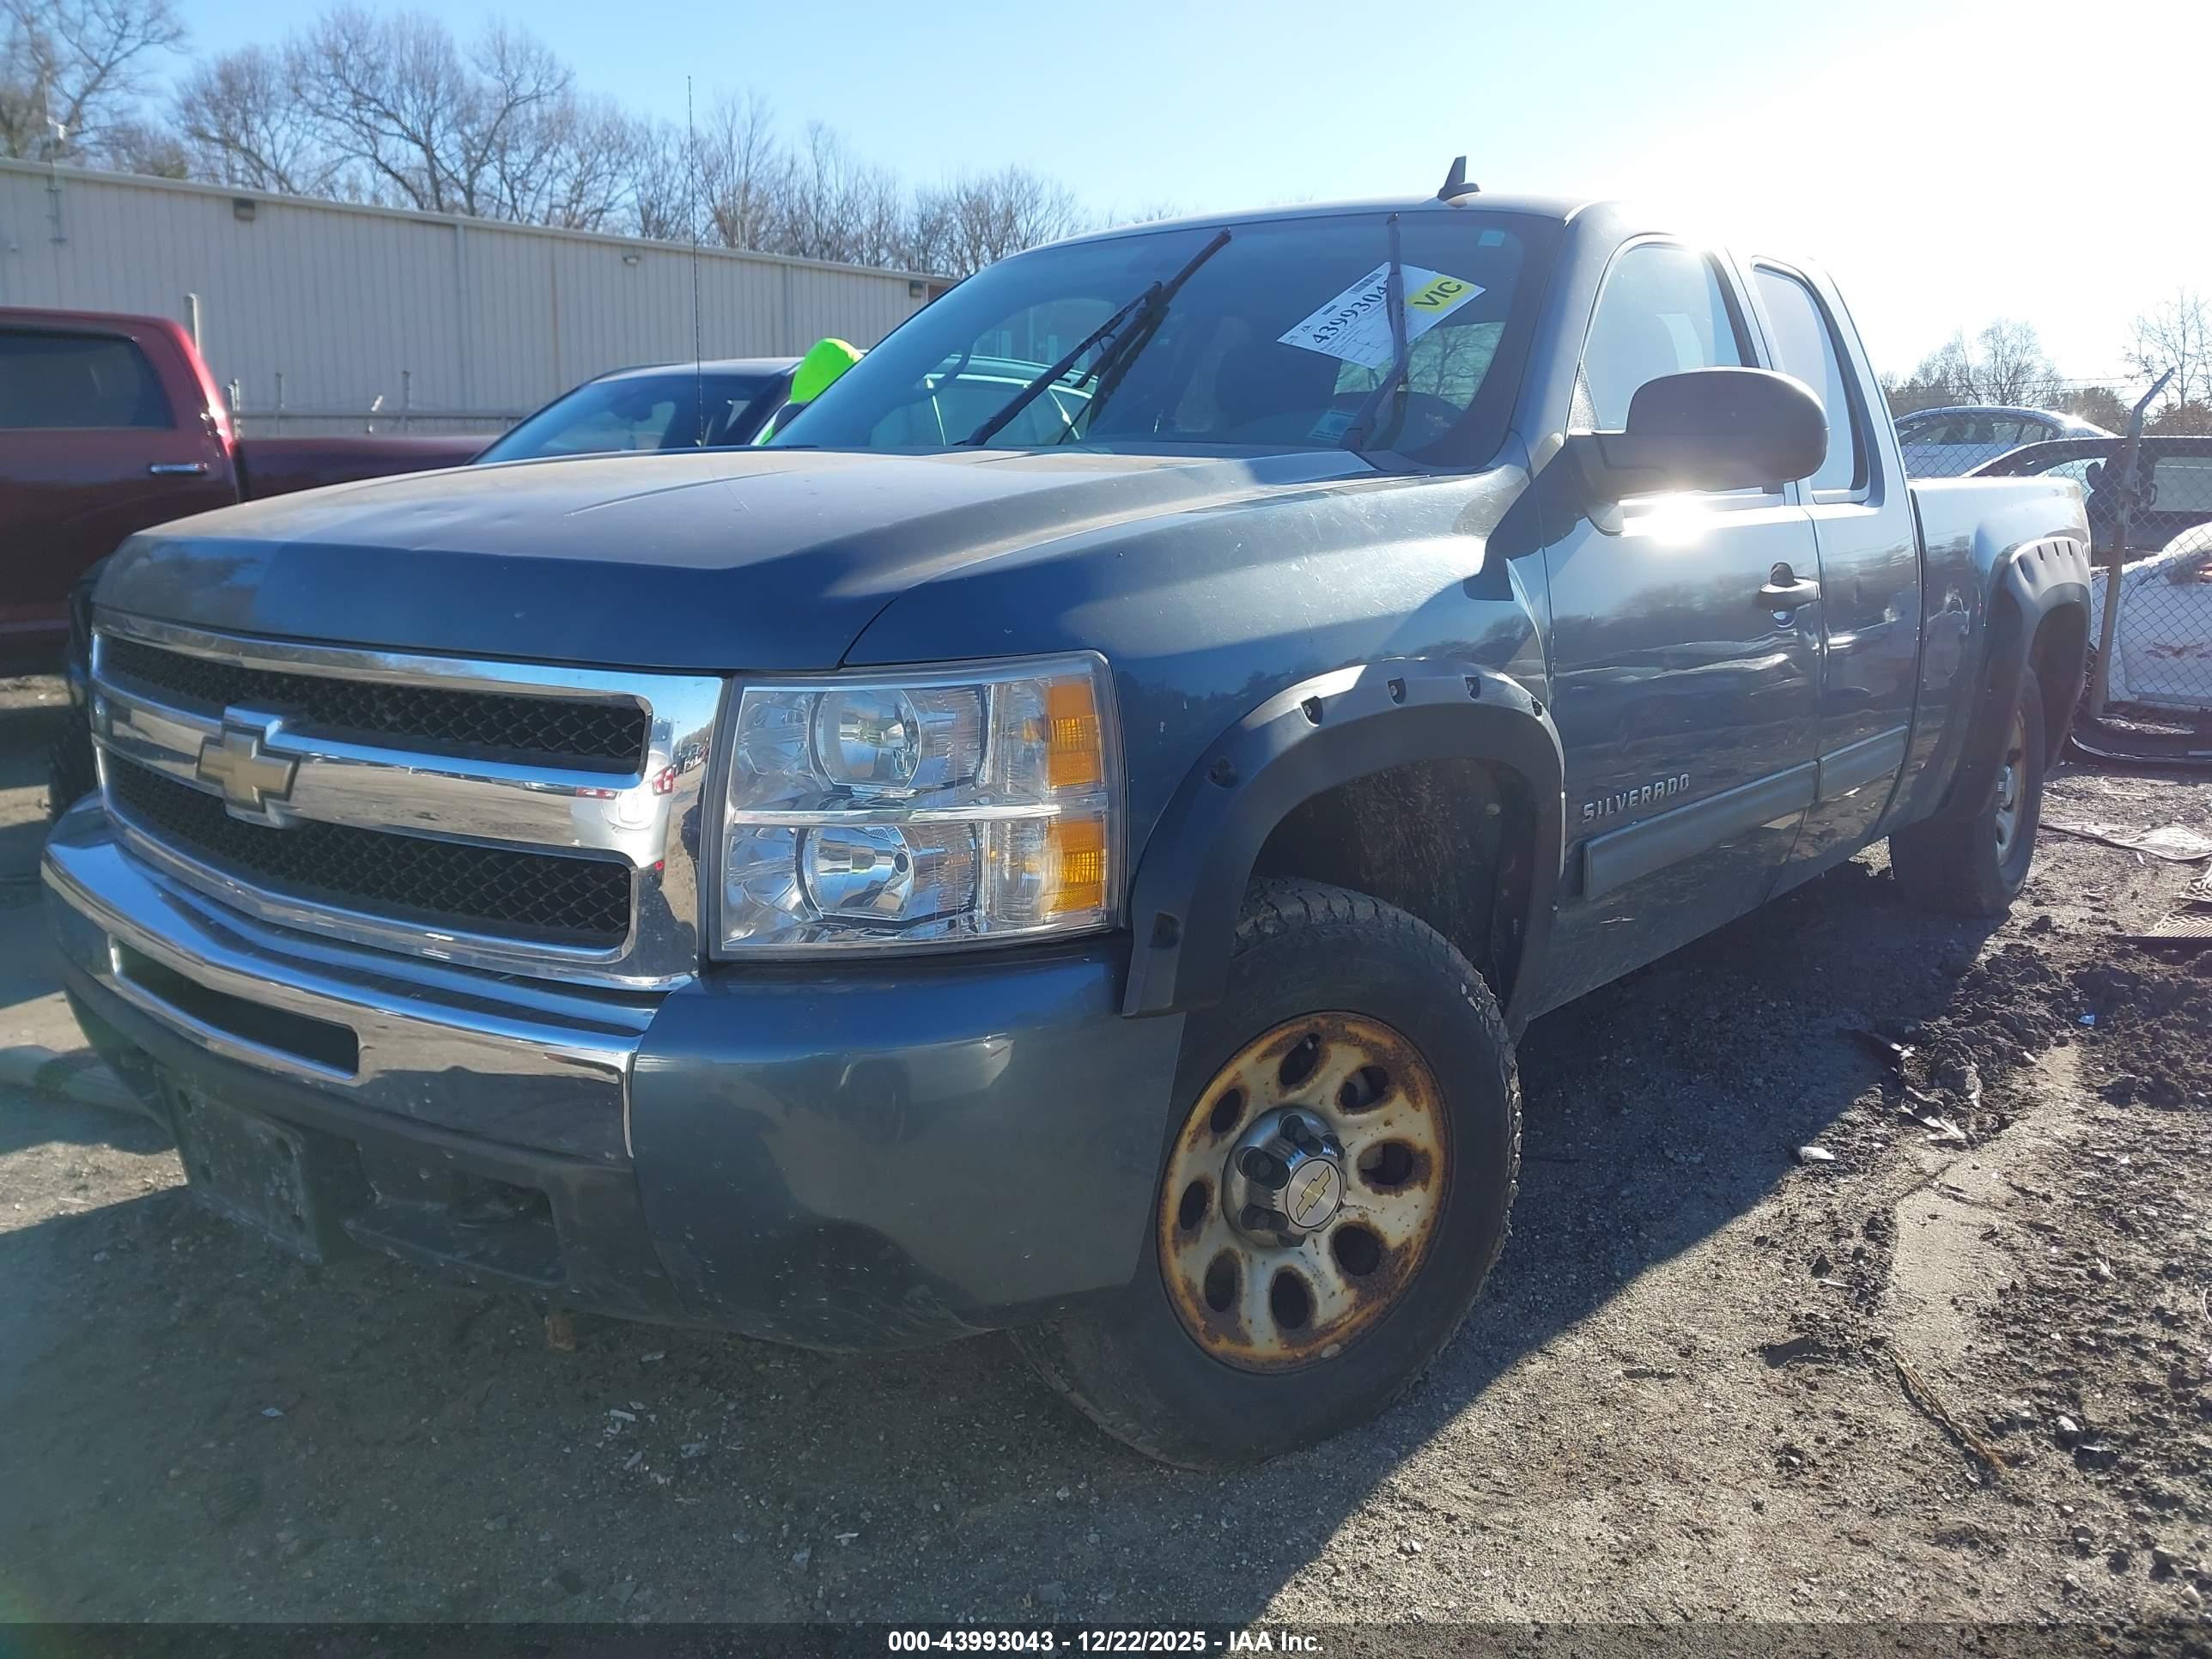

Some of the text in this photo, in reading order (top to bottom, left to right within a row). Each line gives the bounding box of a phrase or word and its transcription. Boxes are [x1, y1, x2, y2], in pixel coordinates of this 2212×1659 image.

[1312, 279, 1389, 343] 4399304
[1413, 281, 1462, 306] VIC
[1582, 773, 1690, 820] SILVERADO
